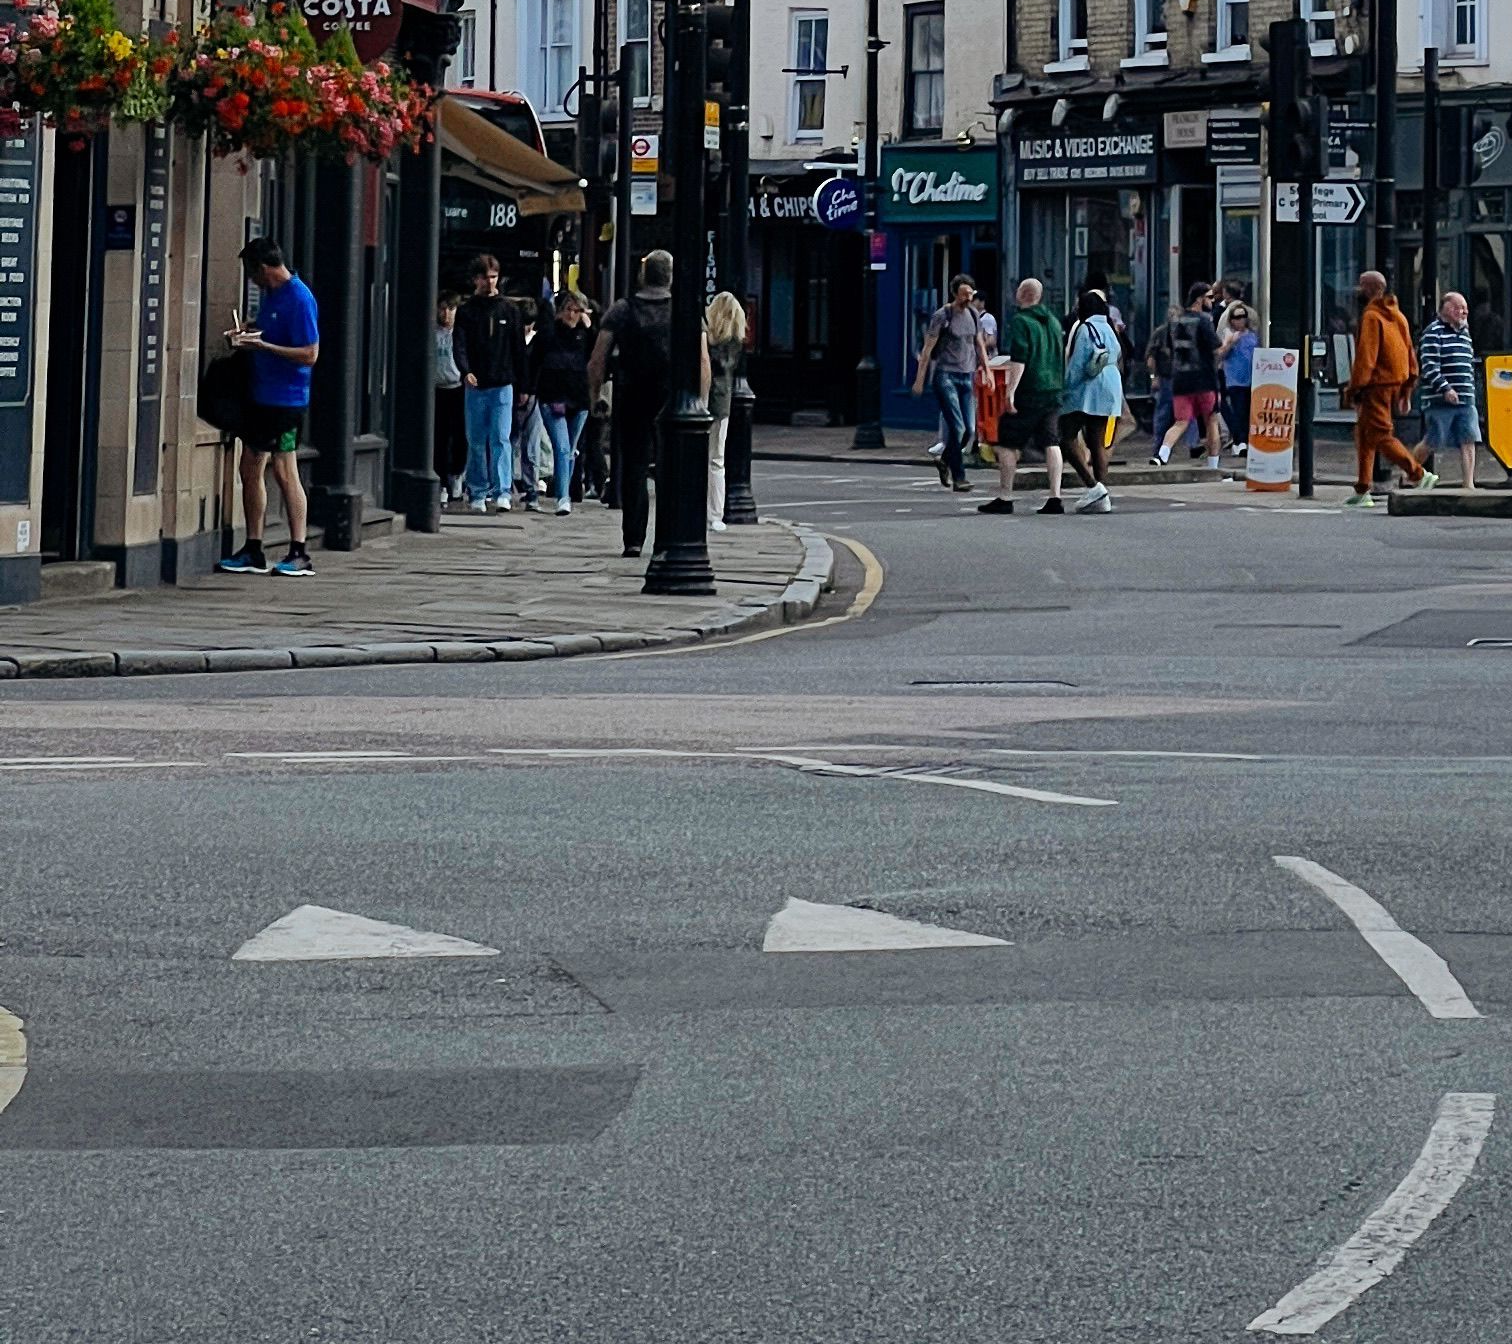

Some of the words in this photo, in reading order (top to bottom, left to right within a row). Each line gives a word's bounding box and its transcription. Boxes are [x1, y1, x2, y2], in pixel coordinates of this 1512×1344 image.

[322, 20, 371, 31] COFEE
[1020, 139, 1052, 160] MUSIC
[1054, 138, 1063, 158] &
[1064, 137, 1096, 158] VIDEO
[1097, 134, 1154, 156] EXCHANGE
[831, 188, 857, 205] Cha
[443, 206, 468, 218] uare
[489, 202, 517, 228] 188
[759, 197, 771, 218] &
[826, 199, 858, 221] time
[1262, 397, 1293, 411] TIME
[1257, 411, 1294, 426] Well
[1249, 424, 1292, 439] SPENT
